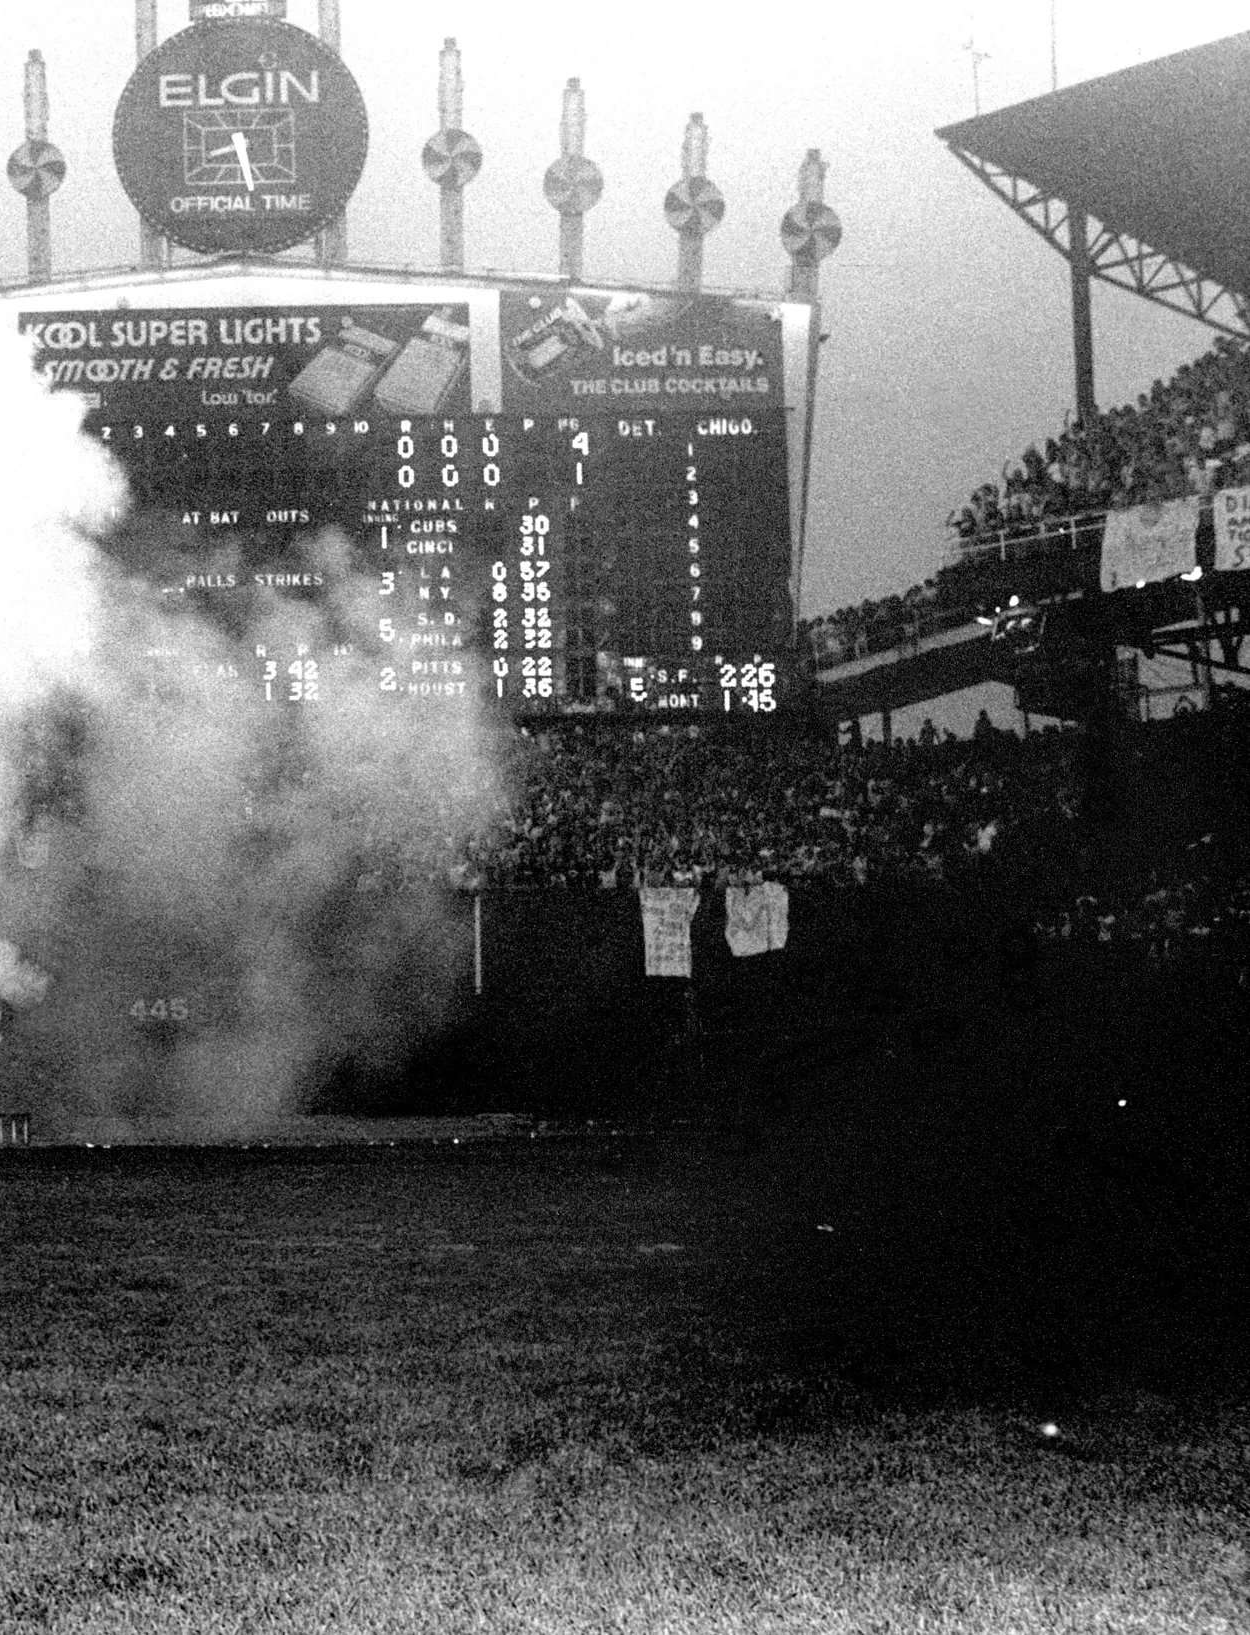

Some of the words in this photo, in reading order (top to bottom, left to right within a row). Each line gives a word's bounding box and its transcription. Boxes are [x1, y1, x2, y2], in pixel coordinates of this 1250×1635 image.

[159, 71, 319, 107] ELGIN
[170, 195, 256, 213] OFFICIAL
[262, 194, 312, 211] TIME
[25, 321, 104, 349] KOOL
[111, 320, 208, 347] SUPER
[219, 317, 322, 345] LIGHTS
[699, 344, 764, 371] Easy.
[44, 358, 155, 382] SMOOTH
[159, 357, 179, 381] &
[186, 355, 275, 380] FRESH
[570, 378, 607, 395] THE
[610, 377, 660, 394] CLUB
[664, 376, 769, 394] COCKTAILS
[201, 389, 238, 405] Low
[102, 426, 111, 440] 2
[134, 425, 144, 439] 3
[164, 425, 175, 438] 4
[196, 424, 207, 438] 5
[228, 423, 239, 437] 6
[261, 422, 270, 436] 7
[293, 421, 304, 436] 8
[325, 422, 336, 436] 9
[353, 421, 369, 434] 10
[523, 418, 535, 431] P
[398, 436, 414, 459] 0
[441, 435, 458, 458] 0
[571, 432, 589, 455] 4
[687, 442, 693, 457] 1
[398, 465, 415, 488] 0
[483, 463, 500, 486] 0
[576, 462, 583, 485] 1
[686, 466, 697, 482] 2
[367, 499, 464, 512] NATIONAL
[528, 496, 539, 510] P
[688, 490, 699, 505] 3
[181, 510, 201, 525] AT
[209, 509, 240, 525] BAT
[266, 508, 310, 523] OUTS
[410, 519, 457, 533] CUBS
[520, 515, 550, 535] 30
[688, 514, 699, 529] 4
[381, 526, 388, 549] 1
[520, 536, 545, 556] 31
[688, 538, 699, 553] 5
[406, 541, 453, 555] CINCI
[254, 572, 324, 587] STRIKES
[520, 561, 550, 581] 57
[689, 562, 700, 578] 6
[379, 572, 395, 595] 3
[492, 582, 507, 602] 8
[691, 586, 700, 601] 7
[493, 608, 508, 628] 2
[521, 608, 551, 628] 32
[690, 611, 701, 626] 8
[379, 619, 395, 642] 5
[493, 629, 508, 649] 2
[524, 629, 551, 649] 32
[411, 633, 462, 648] PHILA
[691, 635, 703, 650] 9
[263, 661, 277, 681] 3
[288, 660, 319, 680] 42
[411, 661, 462, 675] PITTS
[522, 657, 552, 677] 22
[379, 667, 397, 691] 2
[496, 678, 503, 698] 1
[288, 681, 319, 701] 32
[408, 682, 466, 696] HOUST
[658, 693, 699, 709] MONT
[130, 998, 188, 1020] 445
